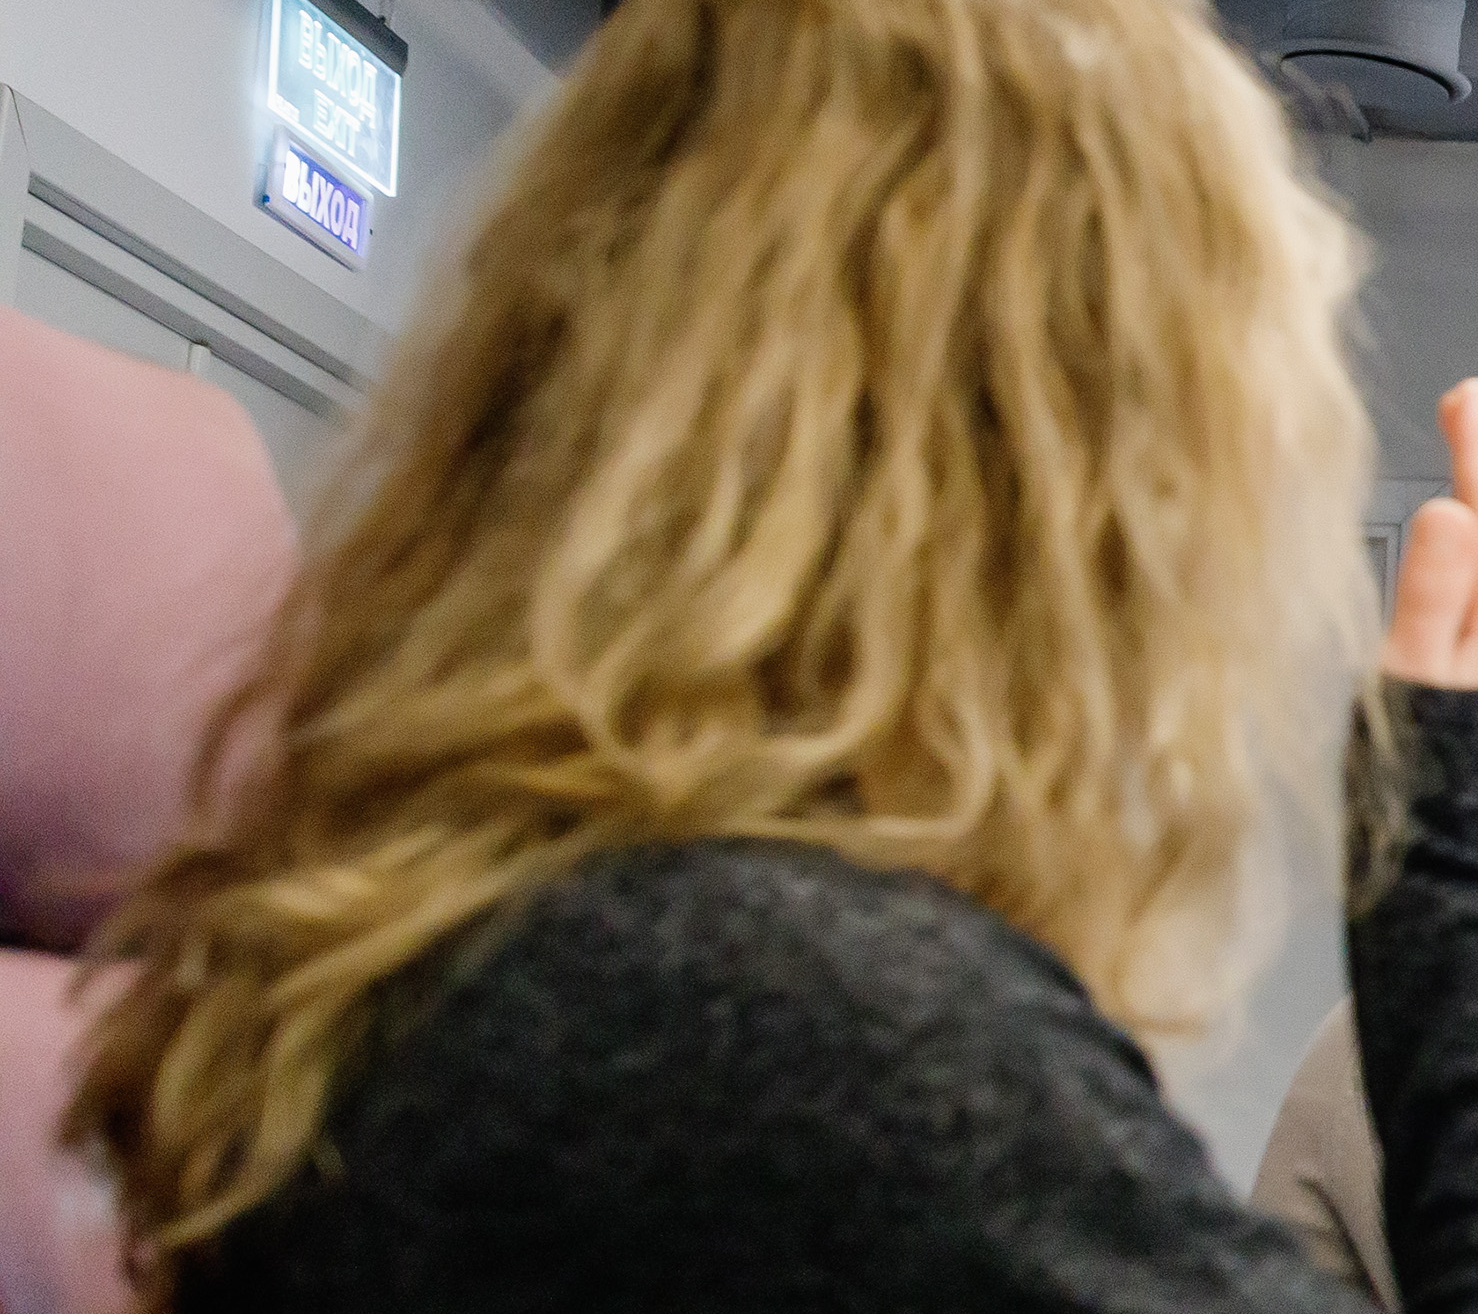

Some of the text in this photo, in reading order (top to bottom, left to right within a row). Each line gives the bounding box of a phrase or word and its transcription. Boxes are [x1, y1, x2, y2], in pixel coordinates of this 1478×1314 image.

[298, 9, 378, 129] ВЫХОД
[313, 89, 360, 158] EXIT
[282, 149, 360, 250] ВЫХОД
